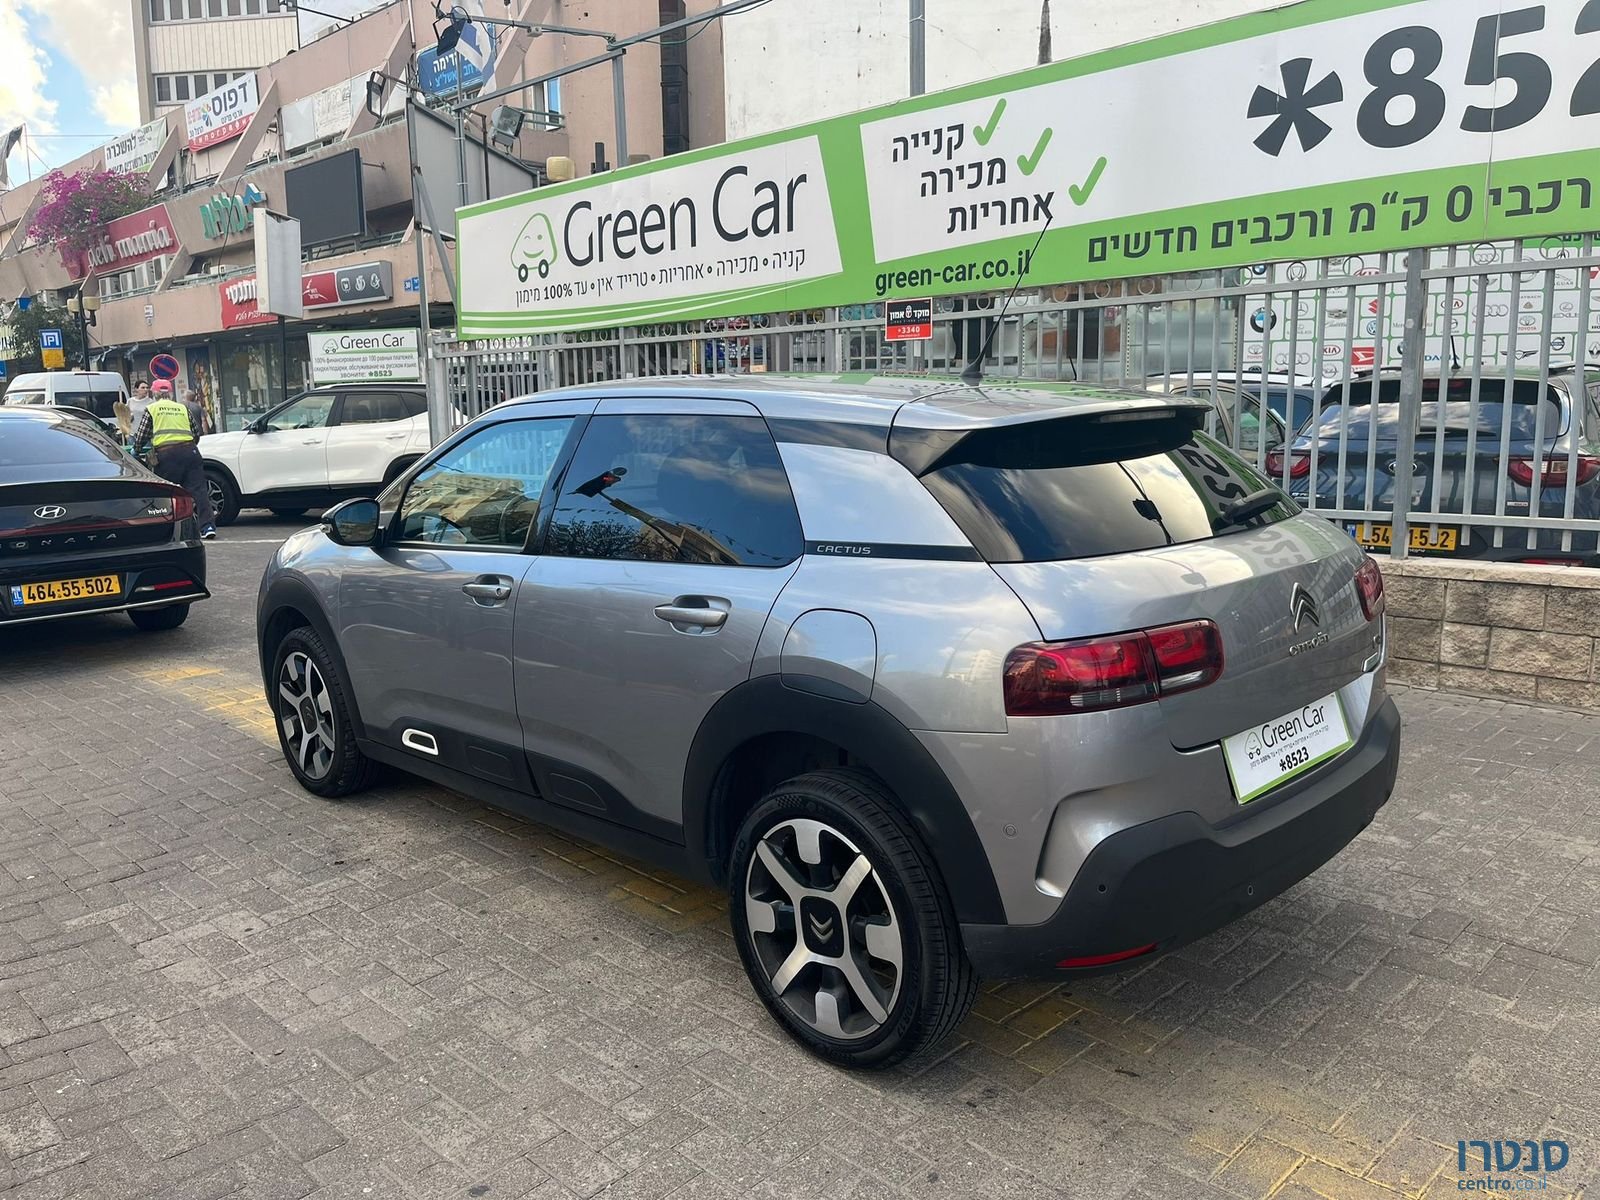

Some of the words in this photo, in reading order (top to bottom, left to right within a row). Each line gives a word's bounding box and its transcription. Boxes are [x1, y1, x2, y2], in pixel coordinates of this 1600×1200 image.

[211, 82, 247, 116] דפוס
[106, 133, 137, 160] להשכרה
[891, 123, 965, 163] קנייה
[920, 157, 1006, 197] מכירה
[1446, 185, 1473, 222] 0
[1488, 177, 1592, 218] רכבי
[563, 197, 698, 267] Green
[712, 165, 808, 243] Car
[946, 191, 1055, 234] אחריות
[115, 220, 173, 258] mania
[1211, 207, 1333, 248] ורכבים
[1087, 224, 1198, 263] חדשים
[716, 256, 758, 277] מכירה
[772, 248, 806, 269] קניה
[617, 271, 648, 290] טרייד
[658, 263, 705, 286] אחריות
[875, 249, 1031, 296] green-car.co.il
[515, 287, 541, 308] מימון
[543, 284, 573, 300] 100%
[574, 280, 588, 296] עד
[596, 279, 613, 297] אין
[889, 311, 905, 321] אמון
[913, 309, 930, 319] מוקד
[340, 335, 380, 350] Green
[382, 333, 405, 348] Car
[147, 507, 168, 515] hybrid
[0, 533, 117, 549] ONATA
[816, 545, 872, 555] CACTUS
[1262, 717, 1303, 748] Green
[1302, 705, 1325, 728] Car
